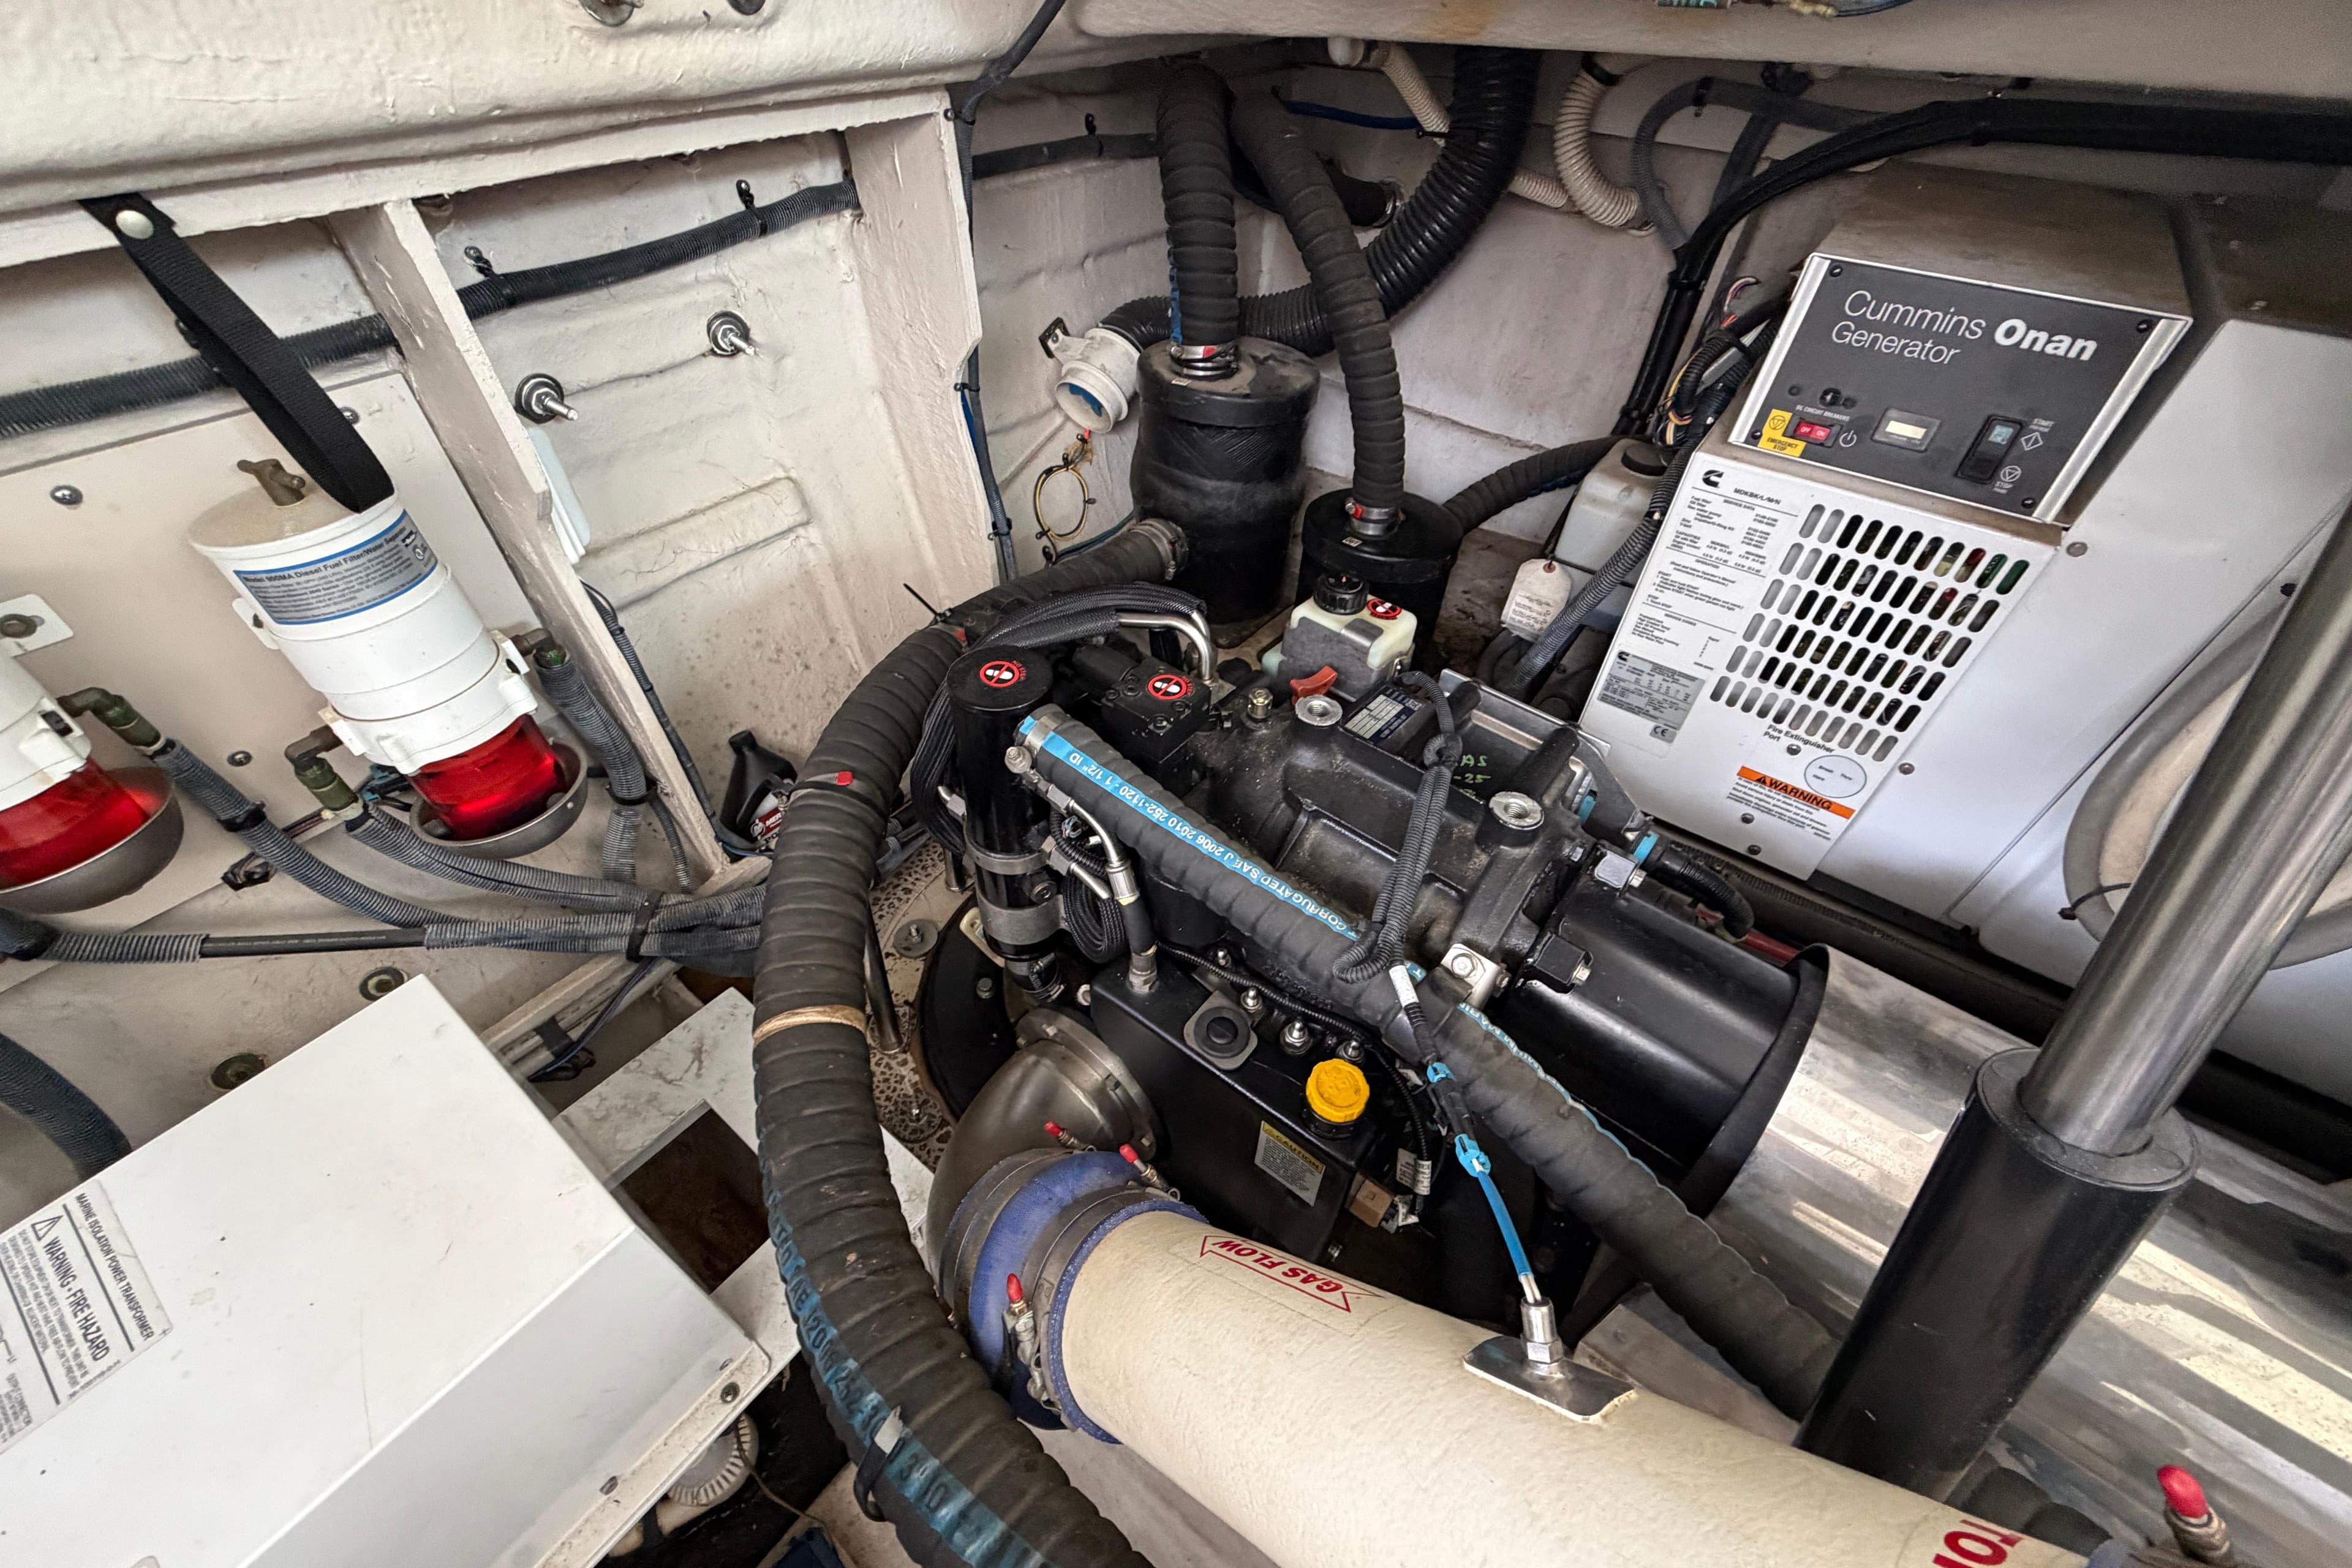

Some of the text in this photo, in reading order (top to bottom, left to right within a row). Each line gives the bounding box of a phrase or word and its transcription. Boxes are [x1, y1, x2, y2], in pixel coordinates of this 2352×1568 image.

[1844, 289, 2098, 362] Cummins Onan
[1831, 320, 1961, 366] Generator
[295, 567, 323, 578] Diesel
[323, 562, 343, 571] Fuel
[1763, 731, 1781, 742] Port
[1767, 725, 1834, 754] Fire Extinguisher
[1069, 752, 1082, 766] ID
[1120, 786, 1166, 822] 252-1120
[1768, 780, 1833, 811] WARNING
[1166, 815, 1195, 837] 2010
[1195, 829, 1224, 857] 2006
[1234, 852, 1262, 880] SAE
[1260, 872, 1349, 933] CORRUGATED
[1275, 1134, 1323, 1172] CAUTION
[43, 1237, 77, 1288] WARNING
[75, 1193, 154, 1341] MARINE ISOLATION POWER TRANSFORMER
[1210, 1240, 1344, 1293] GAS FLOW
[67, 1288, 91, 1317] FIRE
[78, 1312, 110, 1362] HAZARD
